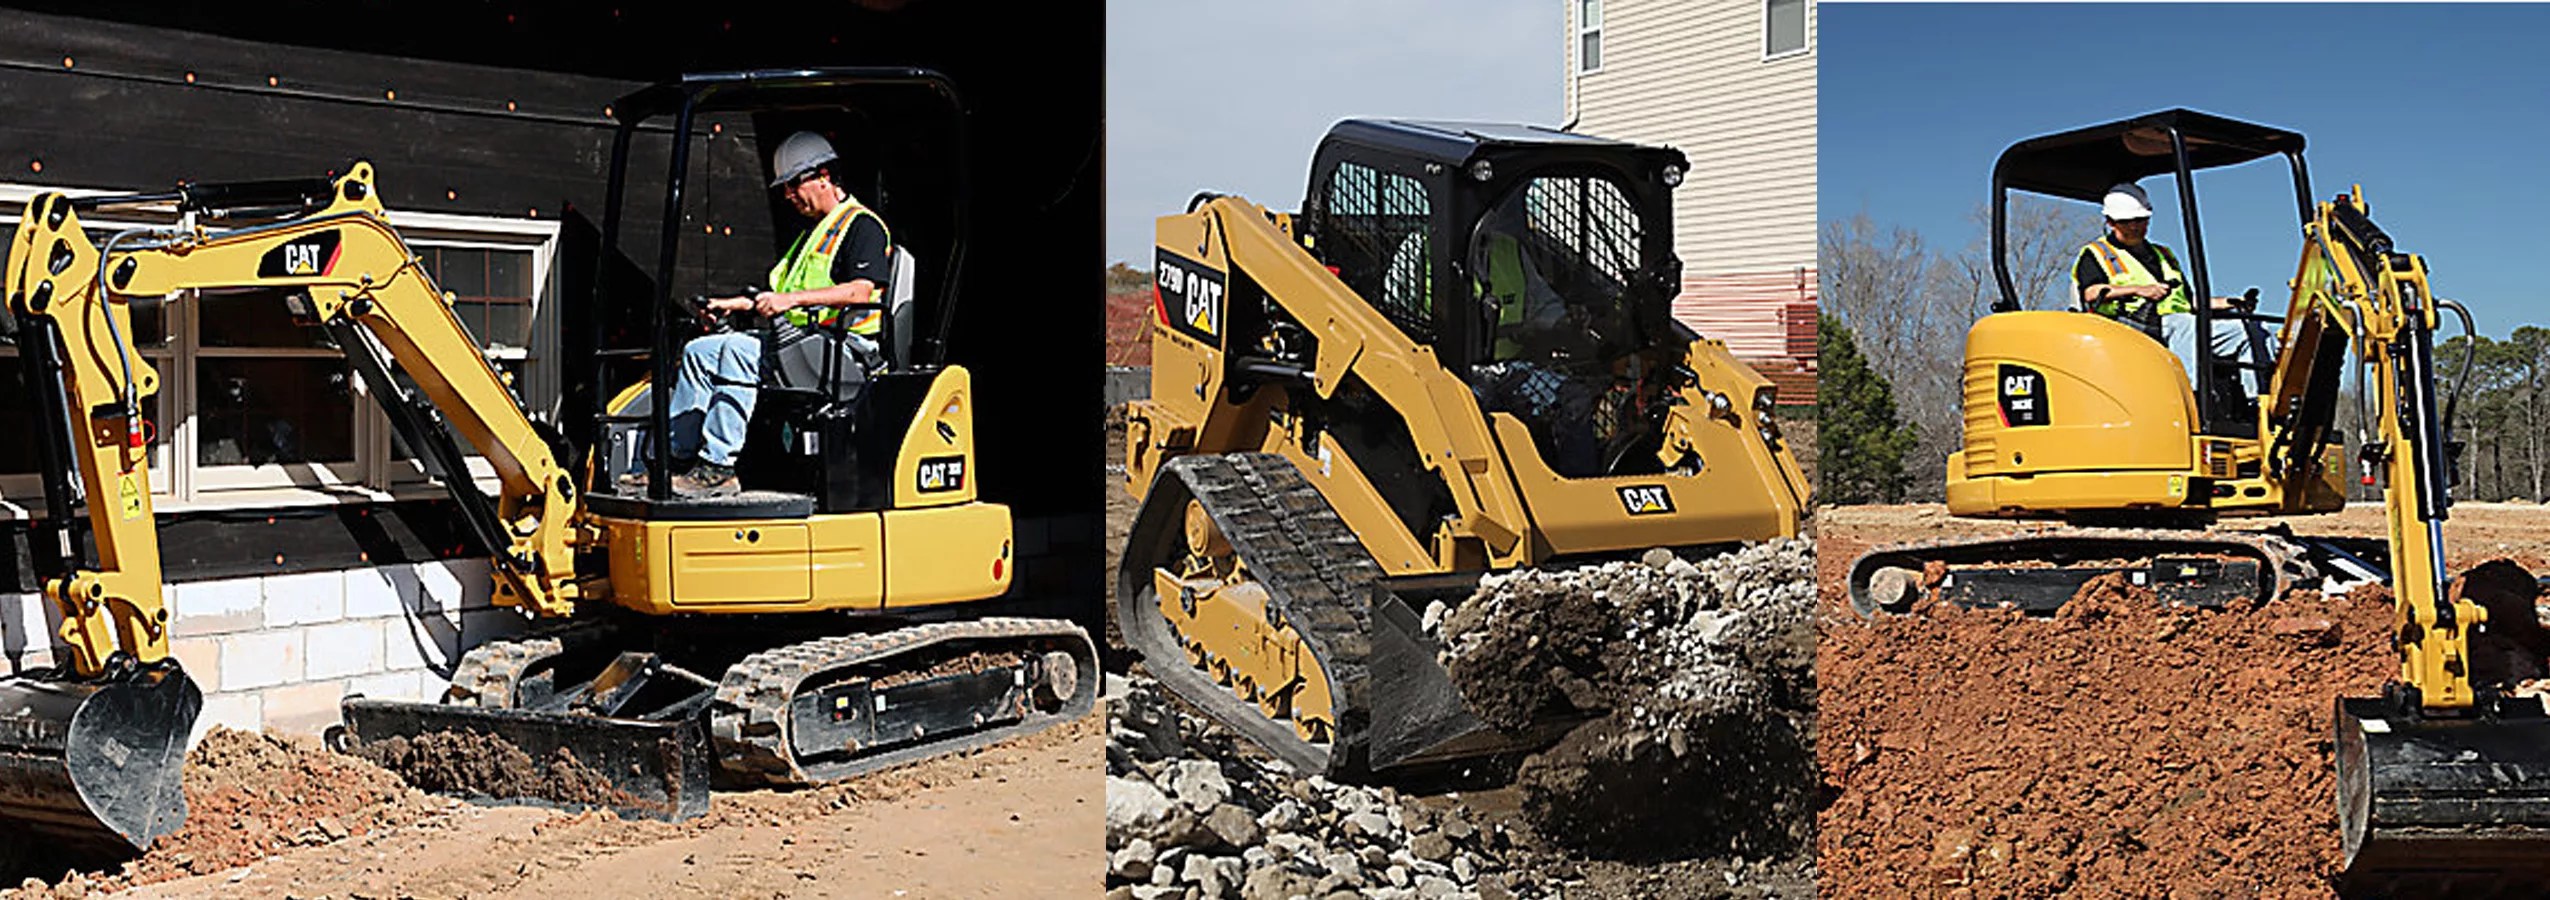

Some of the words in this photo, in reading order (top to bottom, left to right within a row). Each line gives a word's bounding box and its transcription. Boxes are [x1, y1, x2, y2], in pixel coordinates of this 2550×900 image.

[285, 244, 321, 275] CAT
[1185, 271, 1223, 337] CAT
[2004, 374, 2036, 397] CAT
[920, 462, 947, 489] CAT
[1623, 486, 1669, 513] CAT
